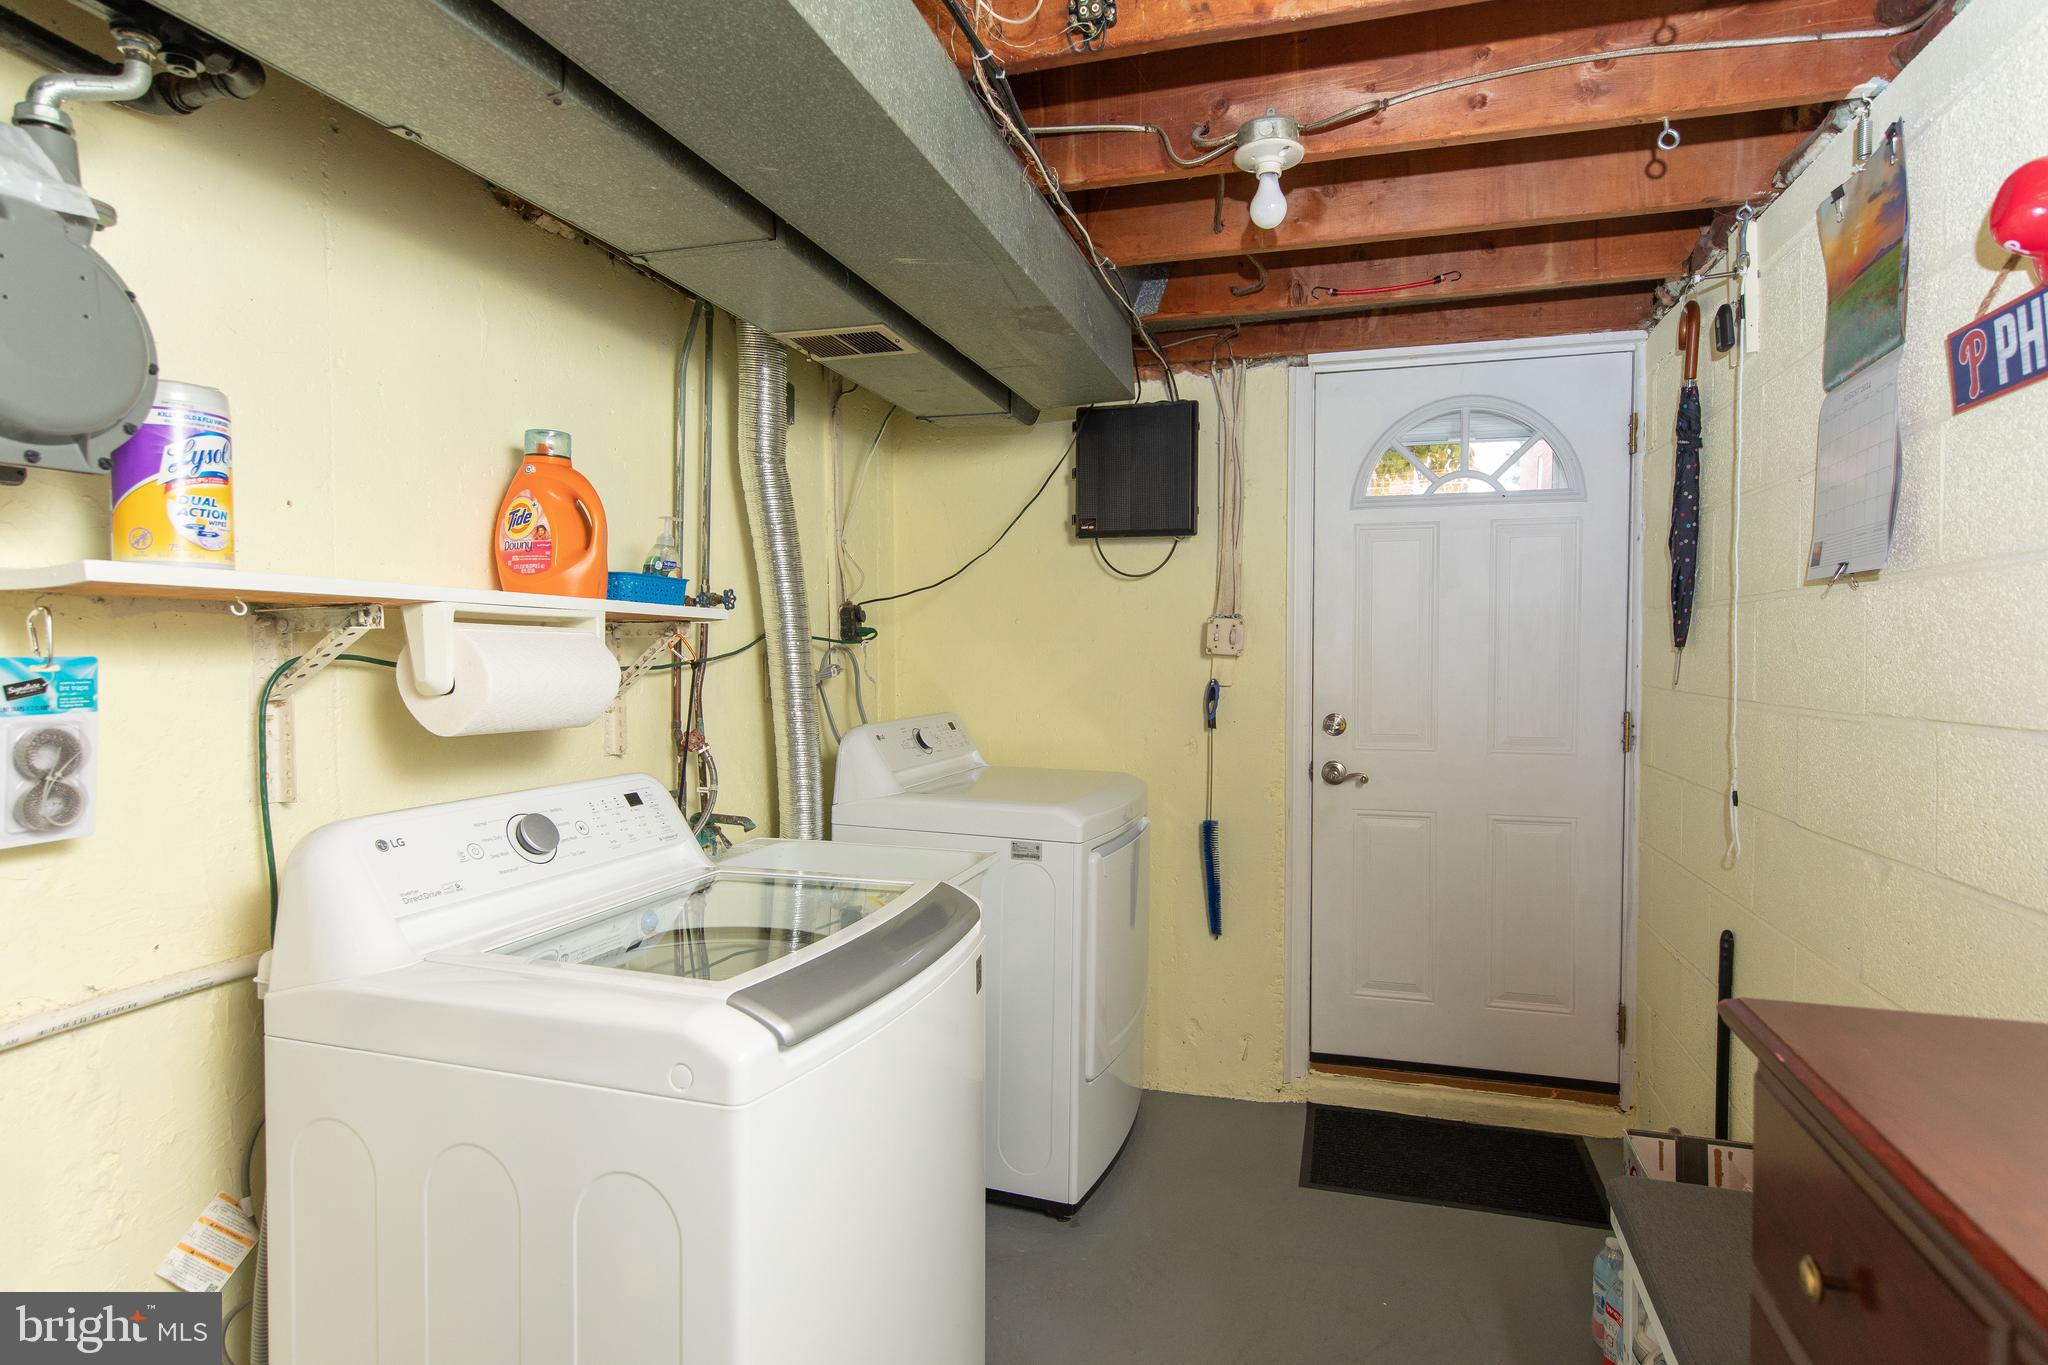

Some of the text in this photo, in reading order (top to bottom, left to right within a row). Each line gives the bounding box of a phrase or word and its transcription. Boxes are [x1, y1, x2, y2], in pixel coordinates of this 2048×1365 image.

[167, 439, 231, 476] Lysol
[179, 496, 217, 508] DUAL
[177, 508, 227, 521] ACTION
[508, 509, 533, 532] Tide
[504, 540, 533, 552] Downy
[389, 837, 406, 848] LG
